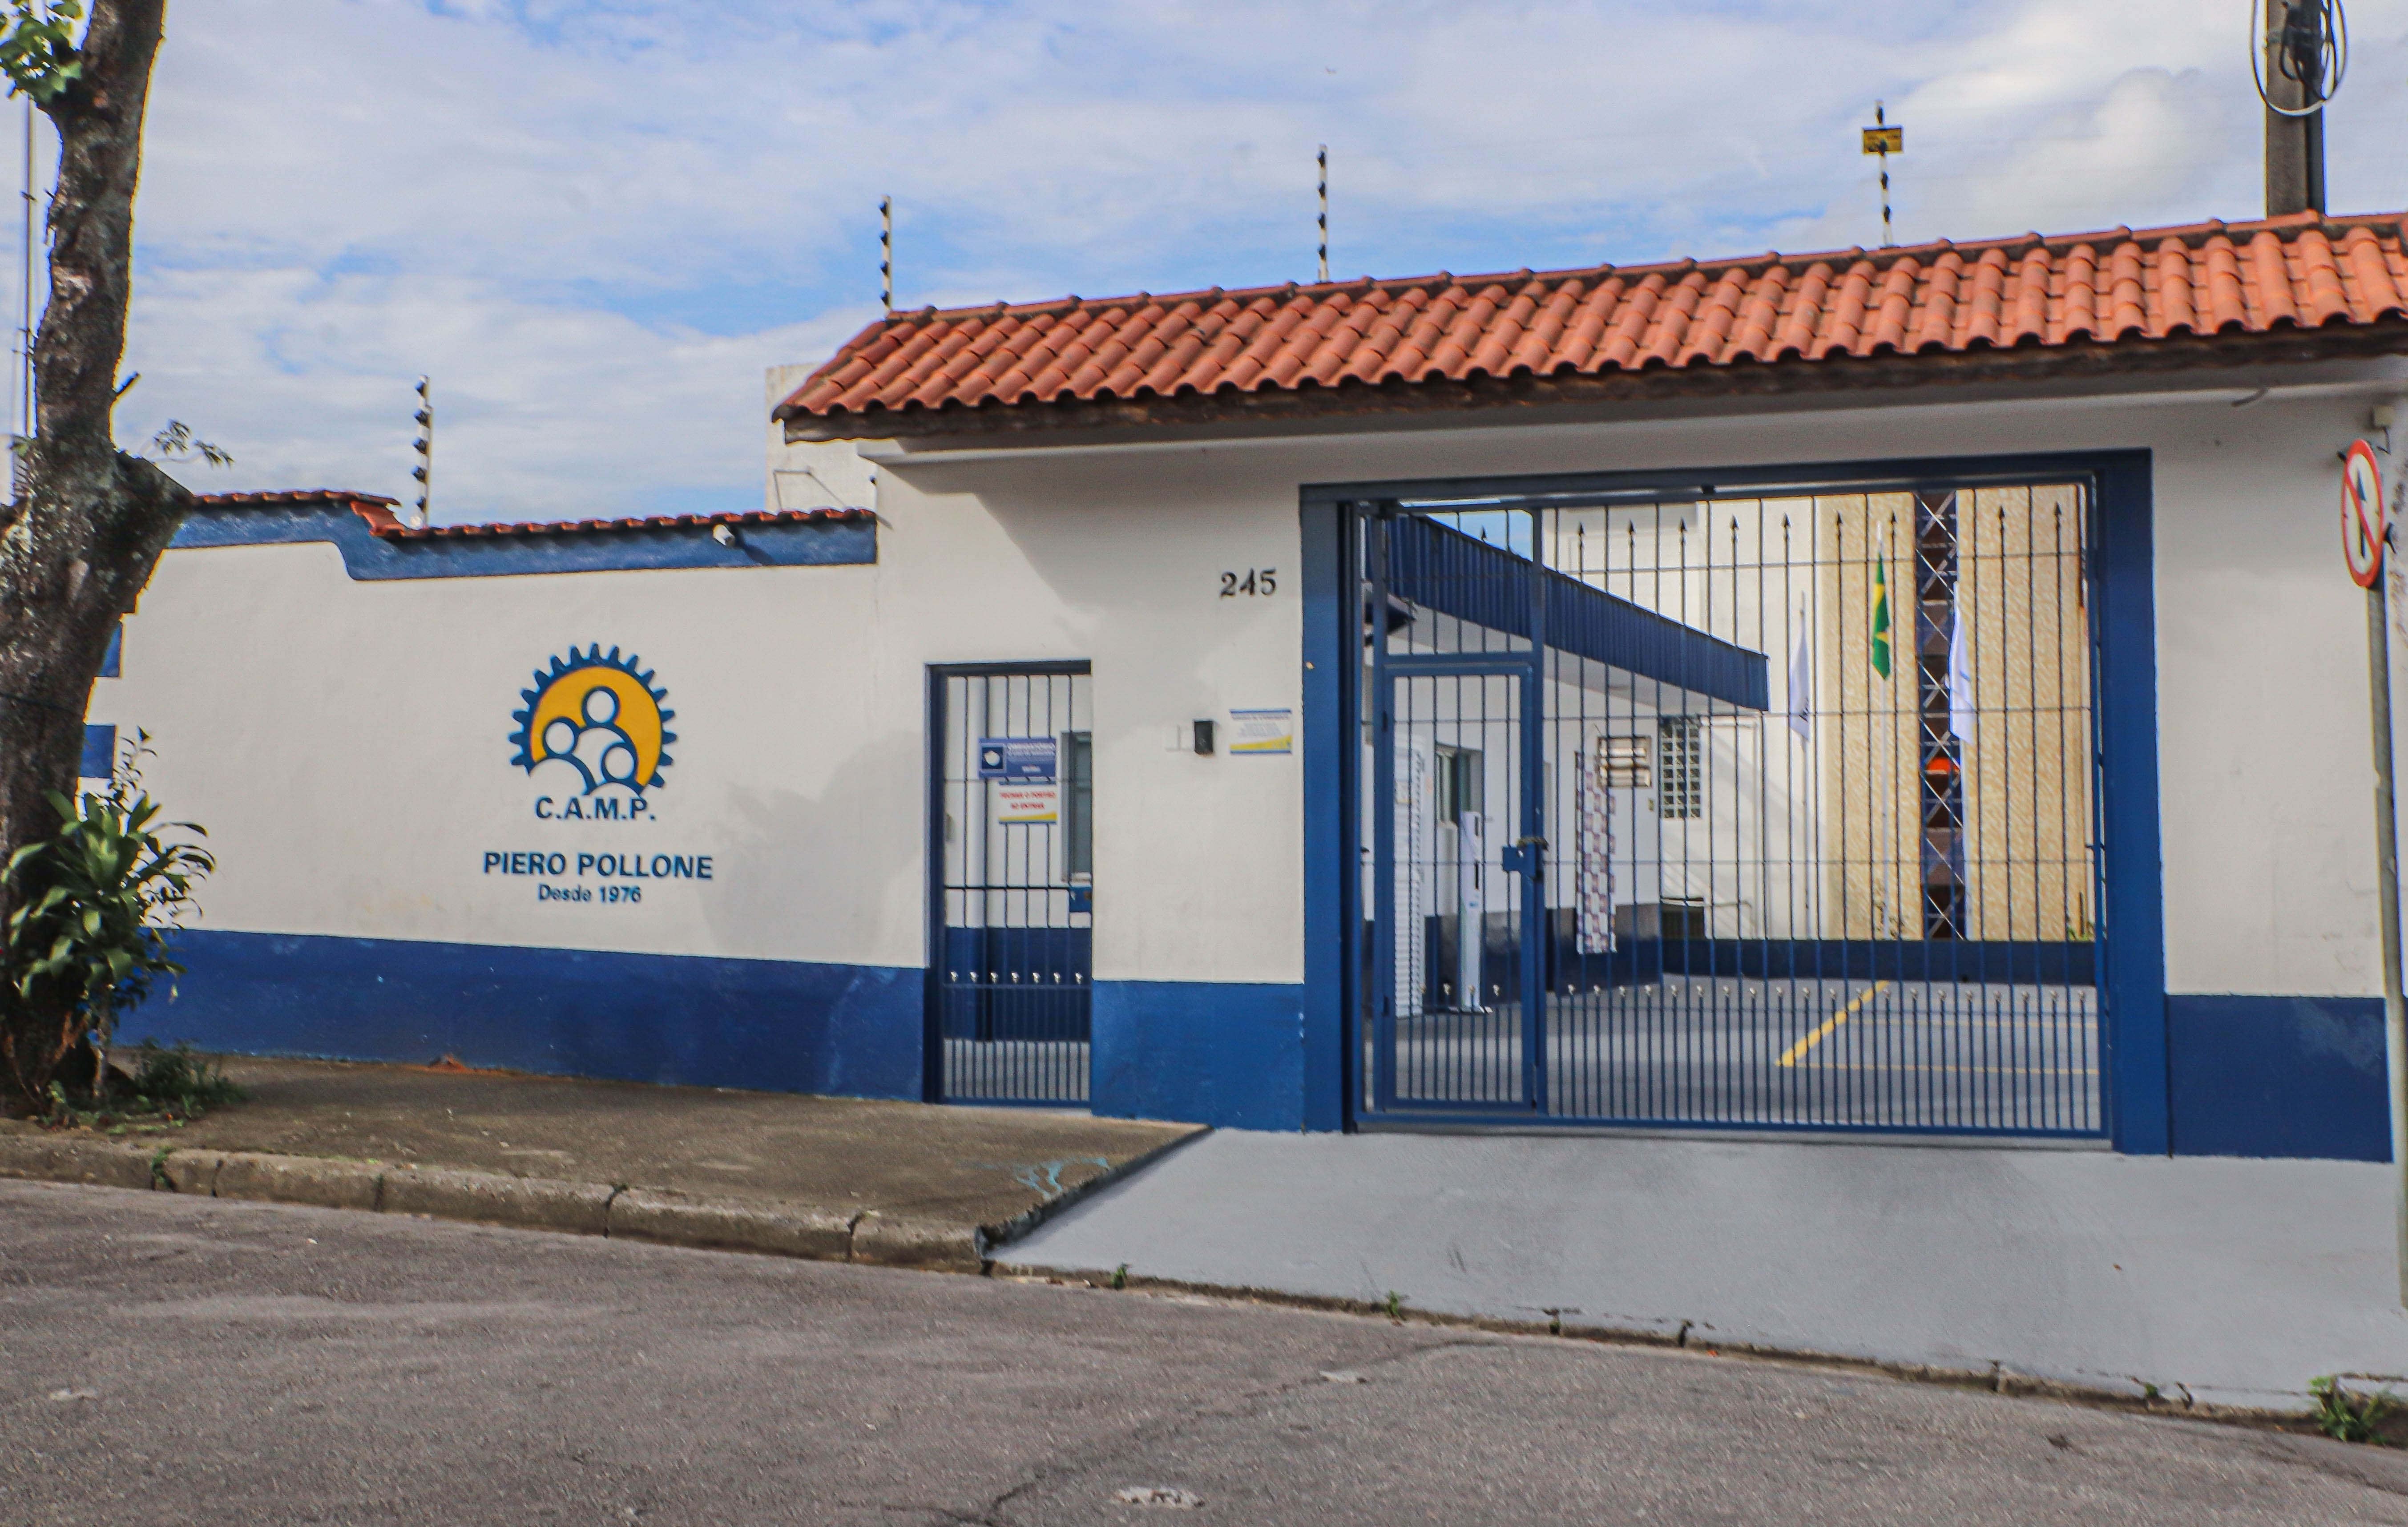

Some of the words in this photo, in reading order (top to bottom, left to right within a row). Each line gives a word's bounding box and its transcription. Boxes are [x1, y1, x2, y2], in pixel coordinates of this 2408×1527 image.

[1220, 567, 1276, 598] 245
[535, 797, 656, 820] C.A.M.P.
[484, 851, 567, 876] PIERO
[577, 852, 713, 880] POLLONE
[537, 883, 592, 902] Desde
[599, 886, 641, 903] 1976
